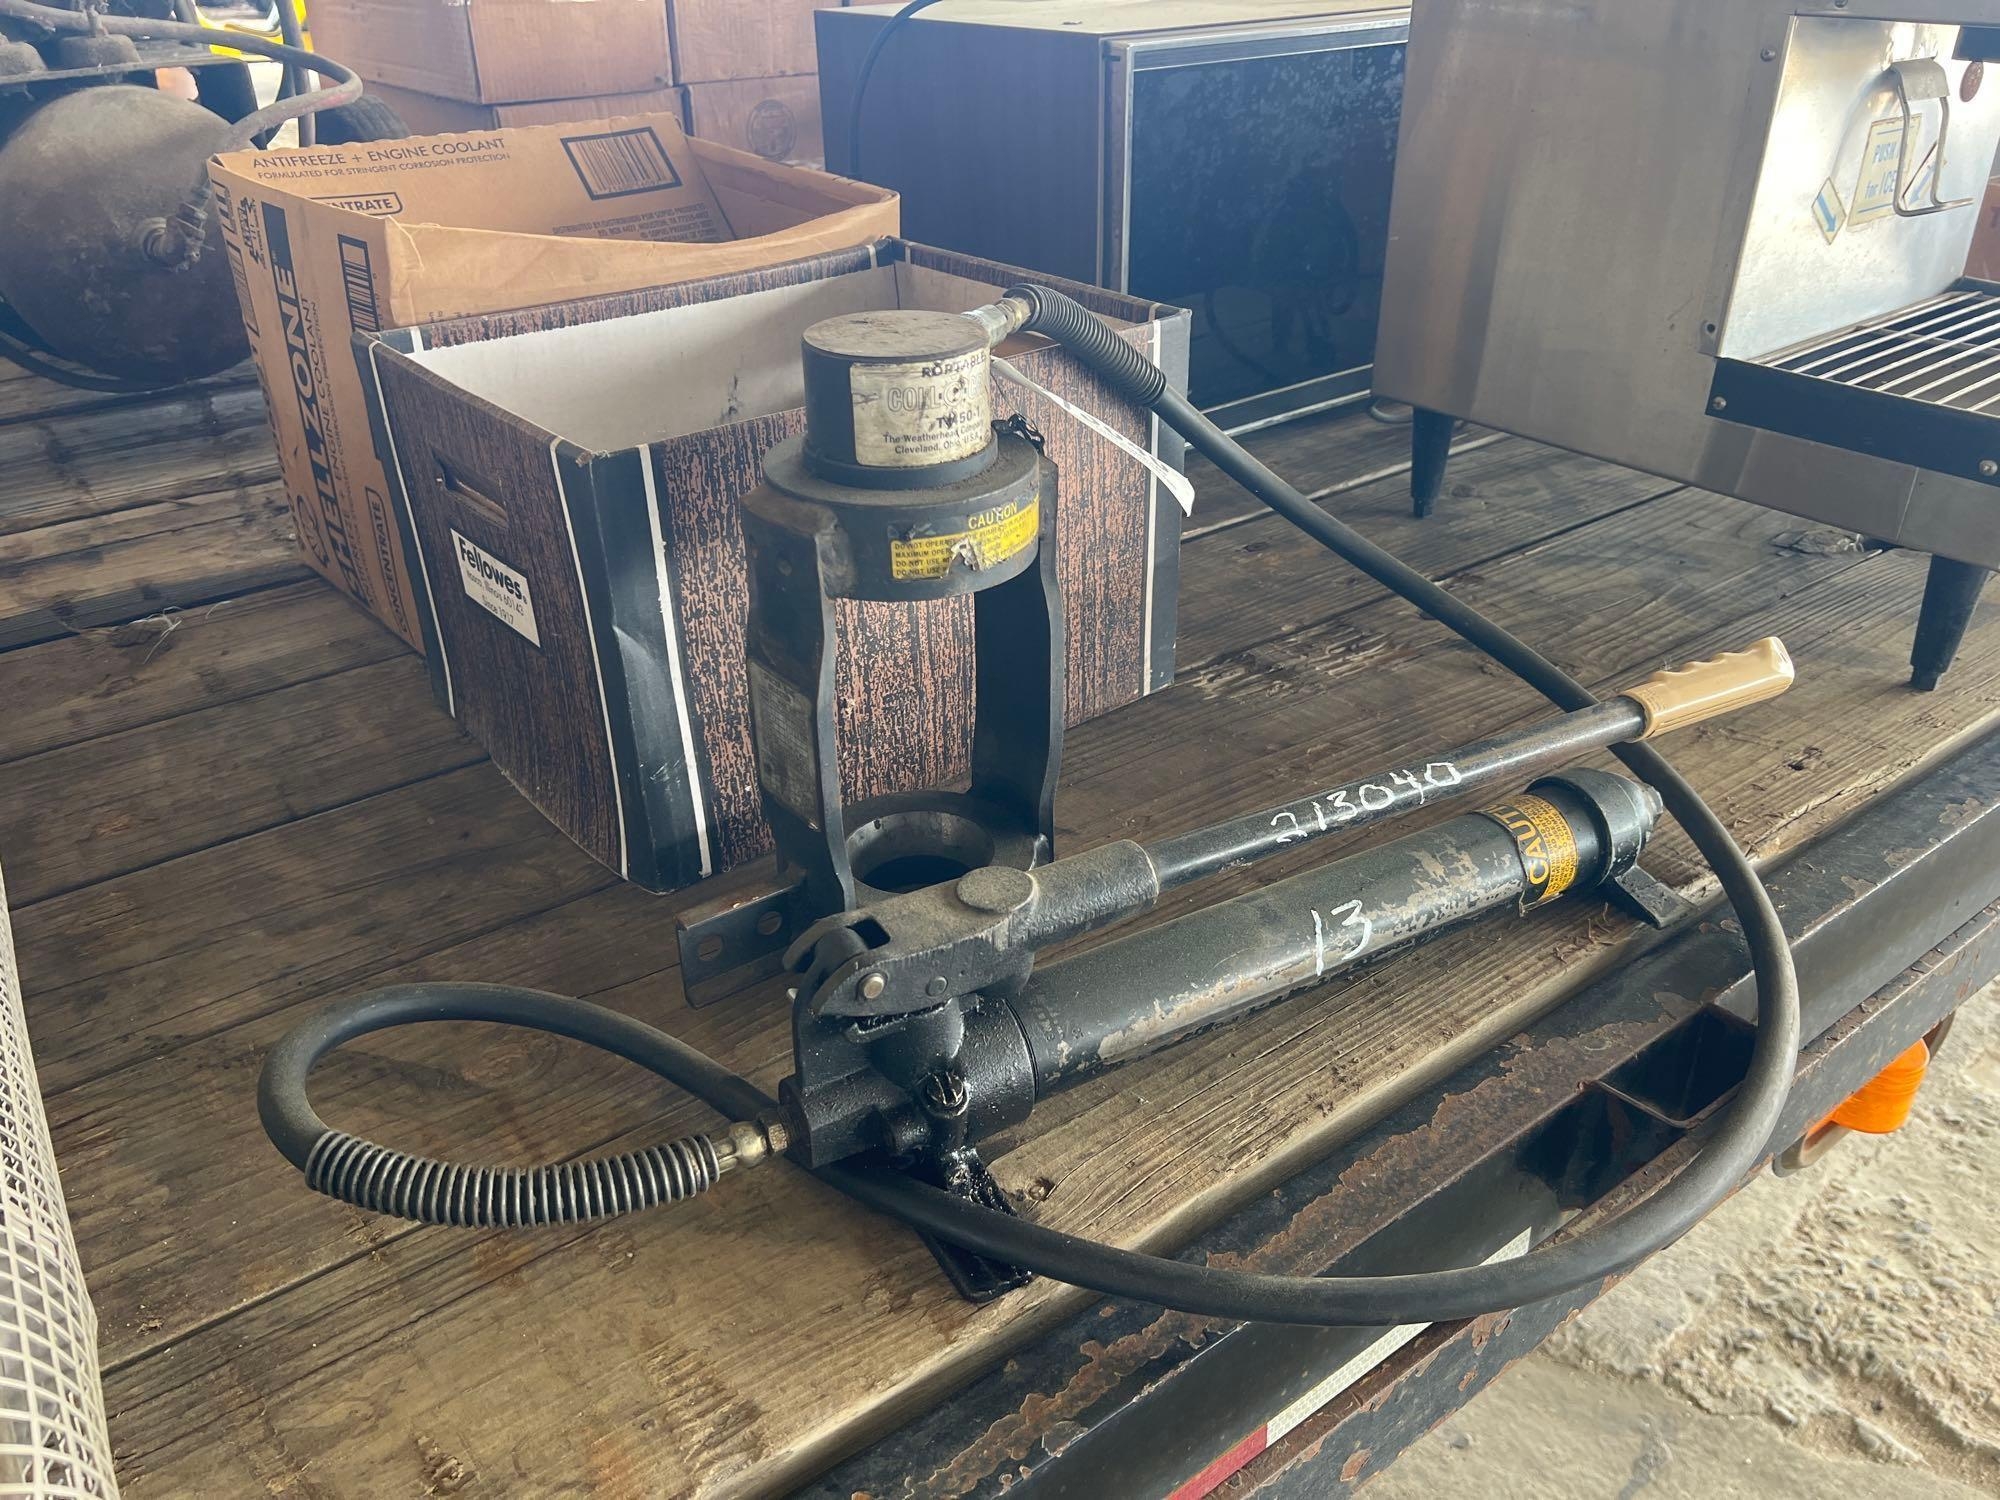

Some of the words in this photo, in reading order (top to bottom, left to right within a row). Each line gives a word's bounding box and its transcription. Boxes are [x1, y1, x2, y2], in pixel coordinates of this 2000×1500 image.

[253, 153, 347, 169] ANTIFREEZE
[367, 146, 429, 161] ENGINE
[432, 138, 505, 155] COOLANT
[258, 169, 322, 179] FORMULATED
[348, 164, 396, 175] STRINGENT
[399, 159, 454, 171] CORROSION
[456, 152, 511, 164] PROTECTION
[1865, 180, 1879, 199] for
[1879, 170, 1897, 194] ICE
[300, 294, 326, 399] COOLANT
[273, 263, 367, 602] SHELLZONE
[320, 404, 342, 480] ENGINE
[883, 431, 901, 443] The
[903, 429, 959, 442] Weatherhead
[895, 550, 929, 558] MAXIMUM
[909, 559, 924, 567] NOT
[926, 558, 940, 566] USE
[909, 568, 924, 576] NOT
[499, 607, 514, 625] 1917
[1270, 762, 1462, 843] 213040
[1310, 900, 1372, 976] 13
